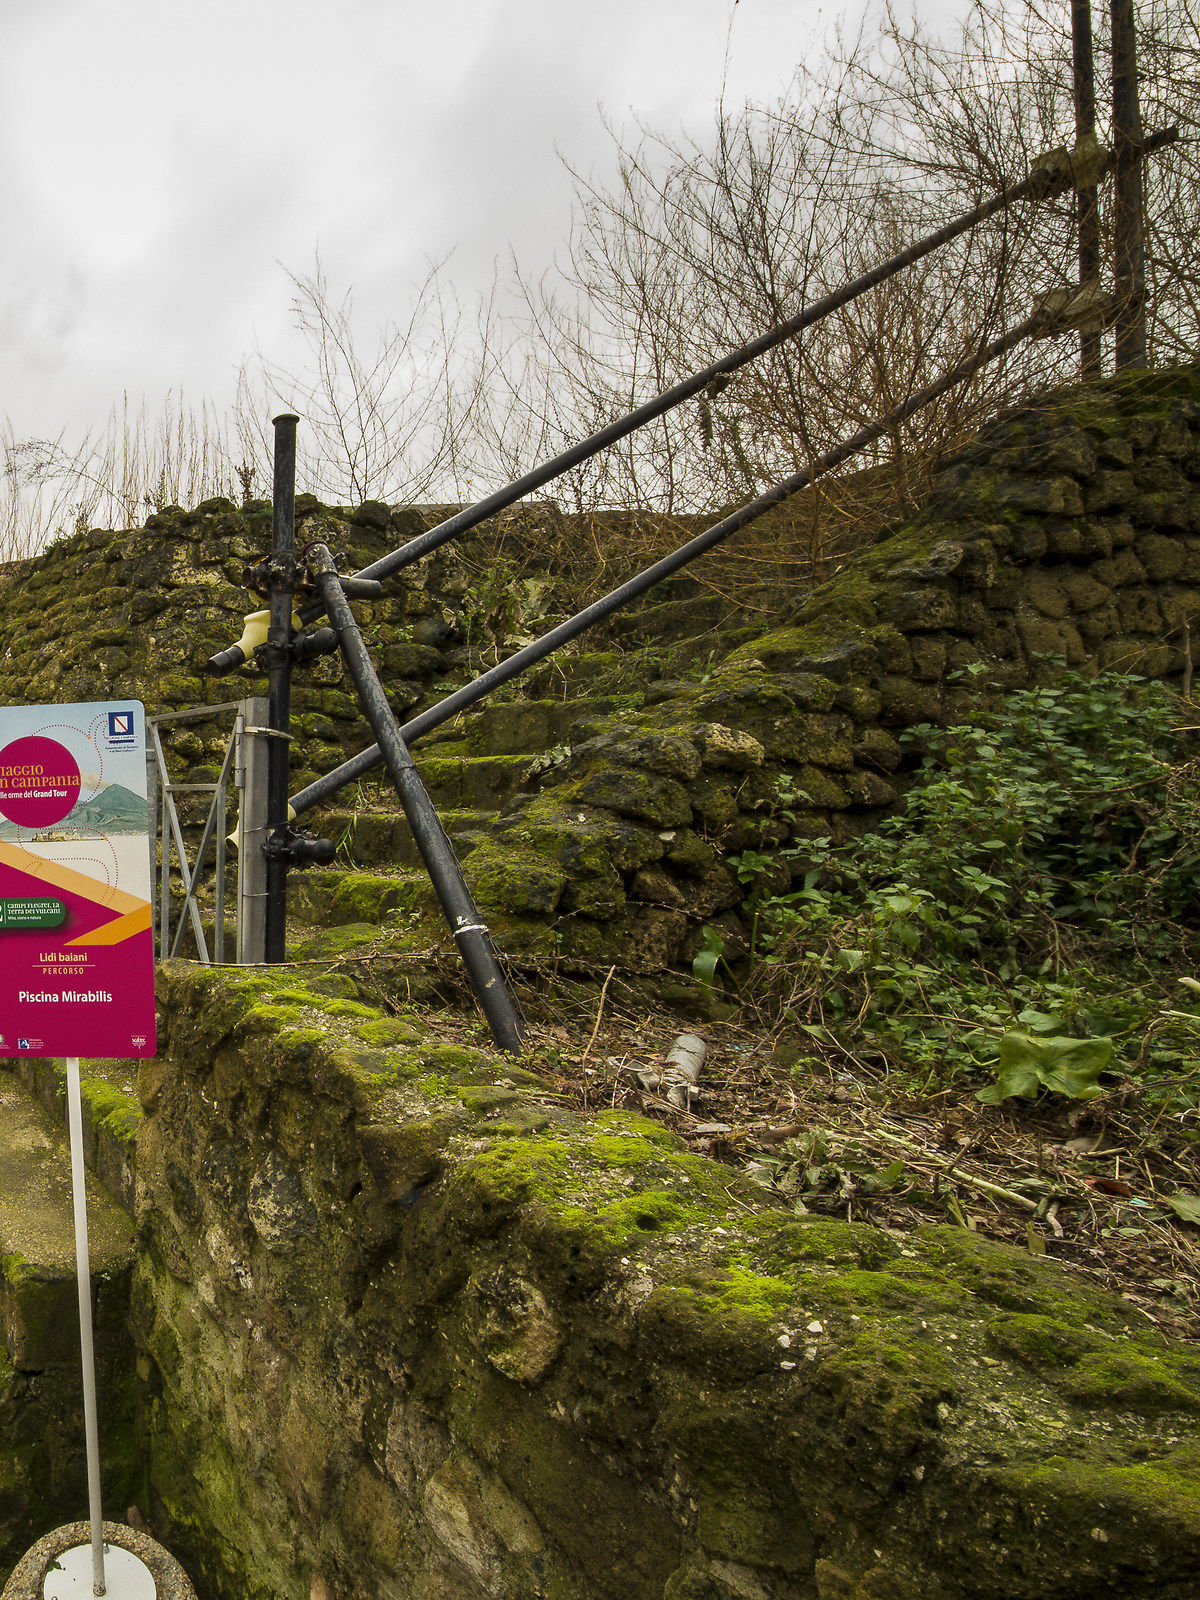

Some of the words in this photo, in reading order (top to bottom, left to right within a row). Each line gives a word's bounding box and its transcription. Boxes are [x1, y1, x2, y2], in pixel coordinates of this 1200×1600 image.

[24, 790, 33, 798] del
[34, 789, 52, 798] Grand
[53, 789, 68, 797] Tour
[40, 952, 57, 962] Lidi
[58, 952, 88, 962] baiani
[43, 967, 85, 975] PERCORSO
[18, 991, 59, 1002] Piscina
[62, 990, 113, 1002] Mirabilis
